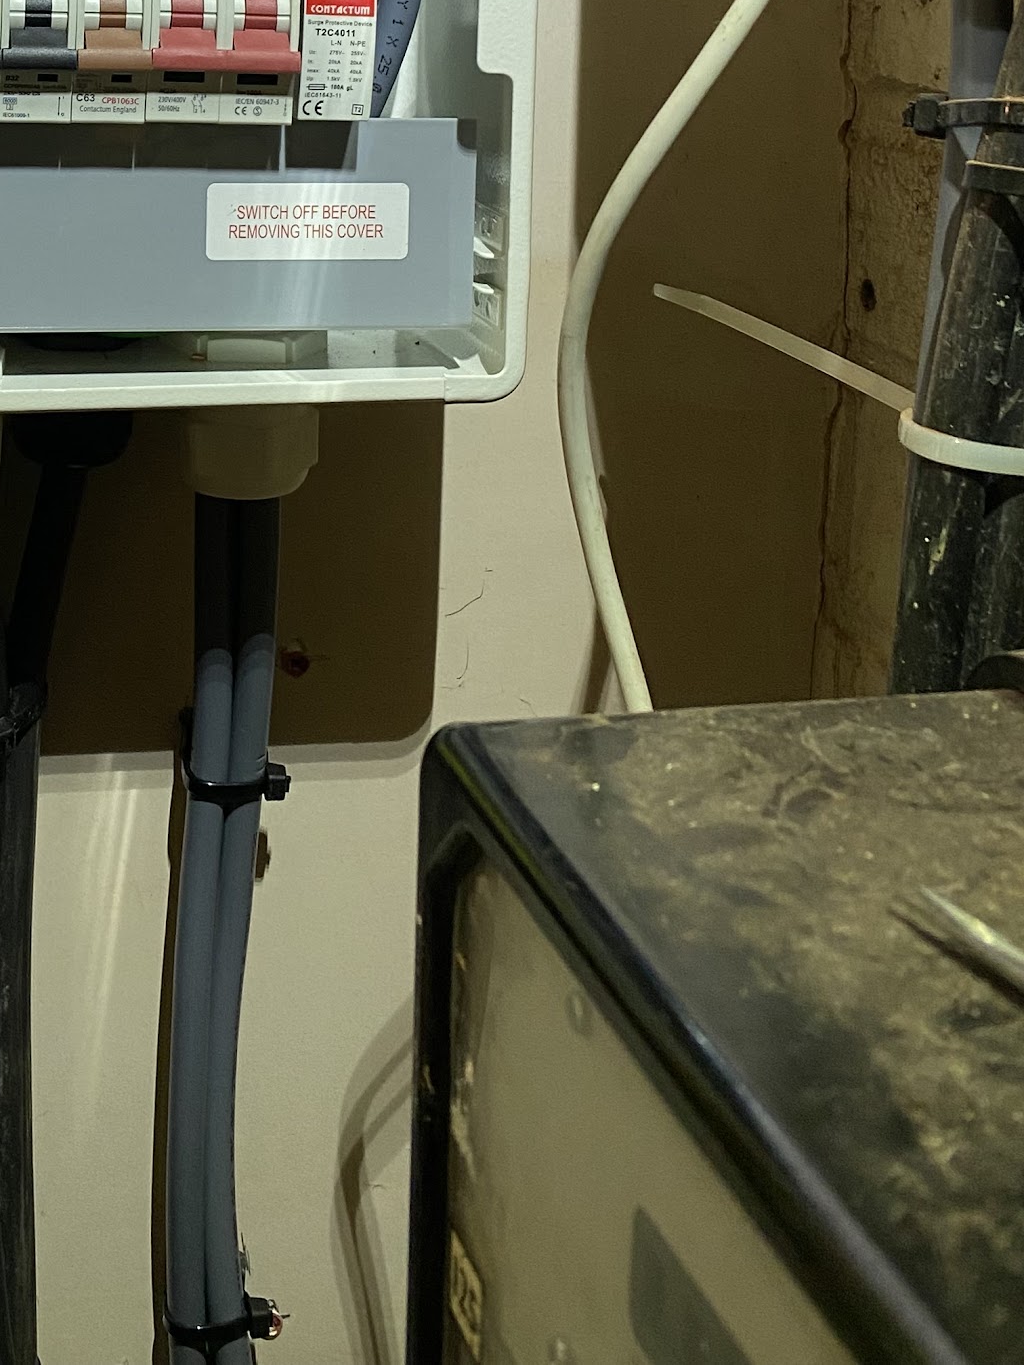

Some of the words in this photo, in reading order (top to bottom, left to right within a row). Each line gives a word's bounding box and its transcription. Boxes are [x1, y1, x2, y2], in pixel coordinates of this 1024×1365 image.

[311, 5, 370, 15] CONTACTUM
[315, 28, 356, 37] T2C4011
[387, 36, 397, 47] X
[76, 94, 95, 102] C63
[102, 97, 139, 105] CPB1063C
[113, 106, 136, 114] England
[237, 205, 288, 219] SWITCH
[293, 205, 318, 219] OFF
[323, 205, 375, 219] BEFORE
[229, 224, 299, 238] REMOVING
[304, 224, 333, 238] THIS
[338, 224, 383, 238] COVER
